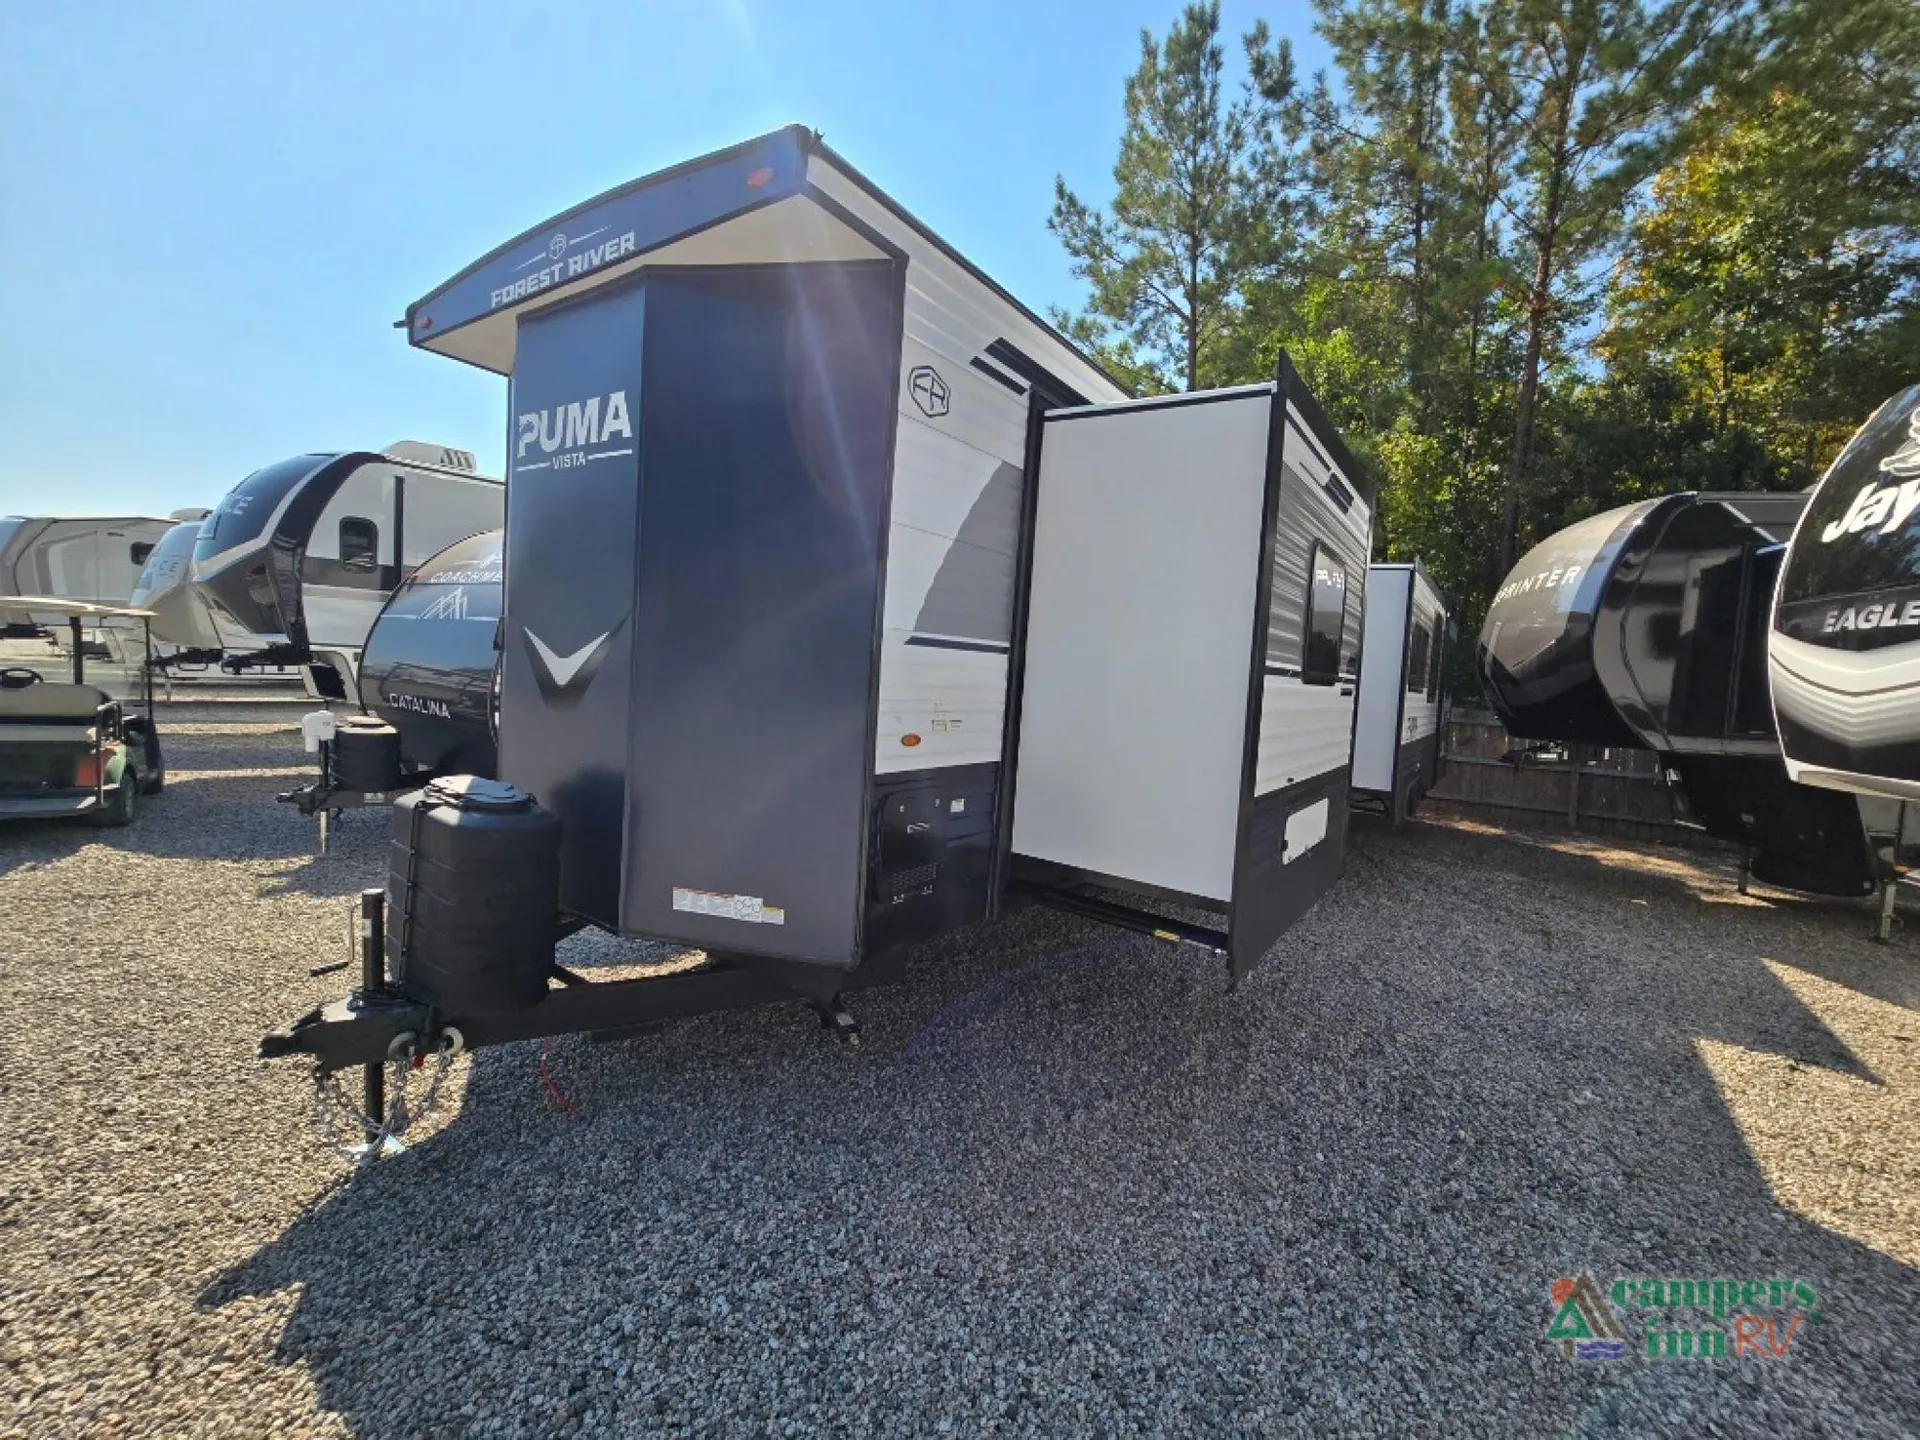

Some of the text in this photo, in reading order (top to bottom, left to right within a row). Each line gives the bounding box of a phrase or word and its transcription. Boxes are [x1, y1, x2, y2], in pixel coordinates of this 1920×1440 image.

[490, 230, 637, 309] FOREST RIVER
[517, 390, 632, 458] PUMA
[552, 451, 586, 470] VISTA
[1822, 600, 1920, 633] EAGLE
[389, 692, 451, 719] CATALINA
